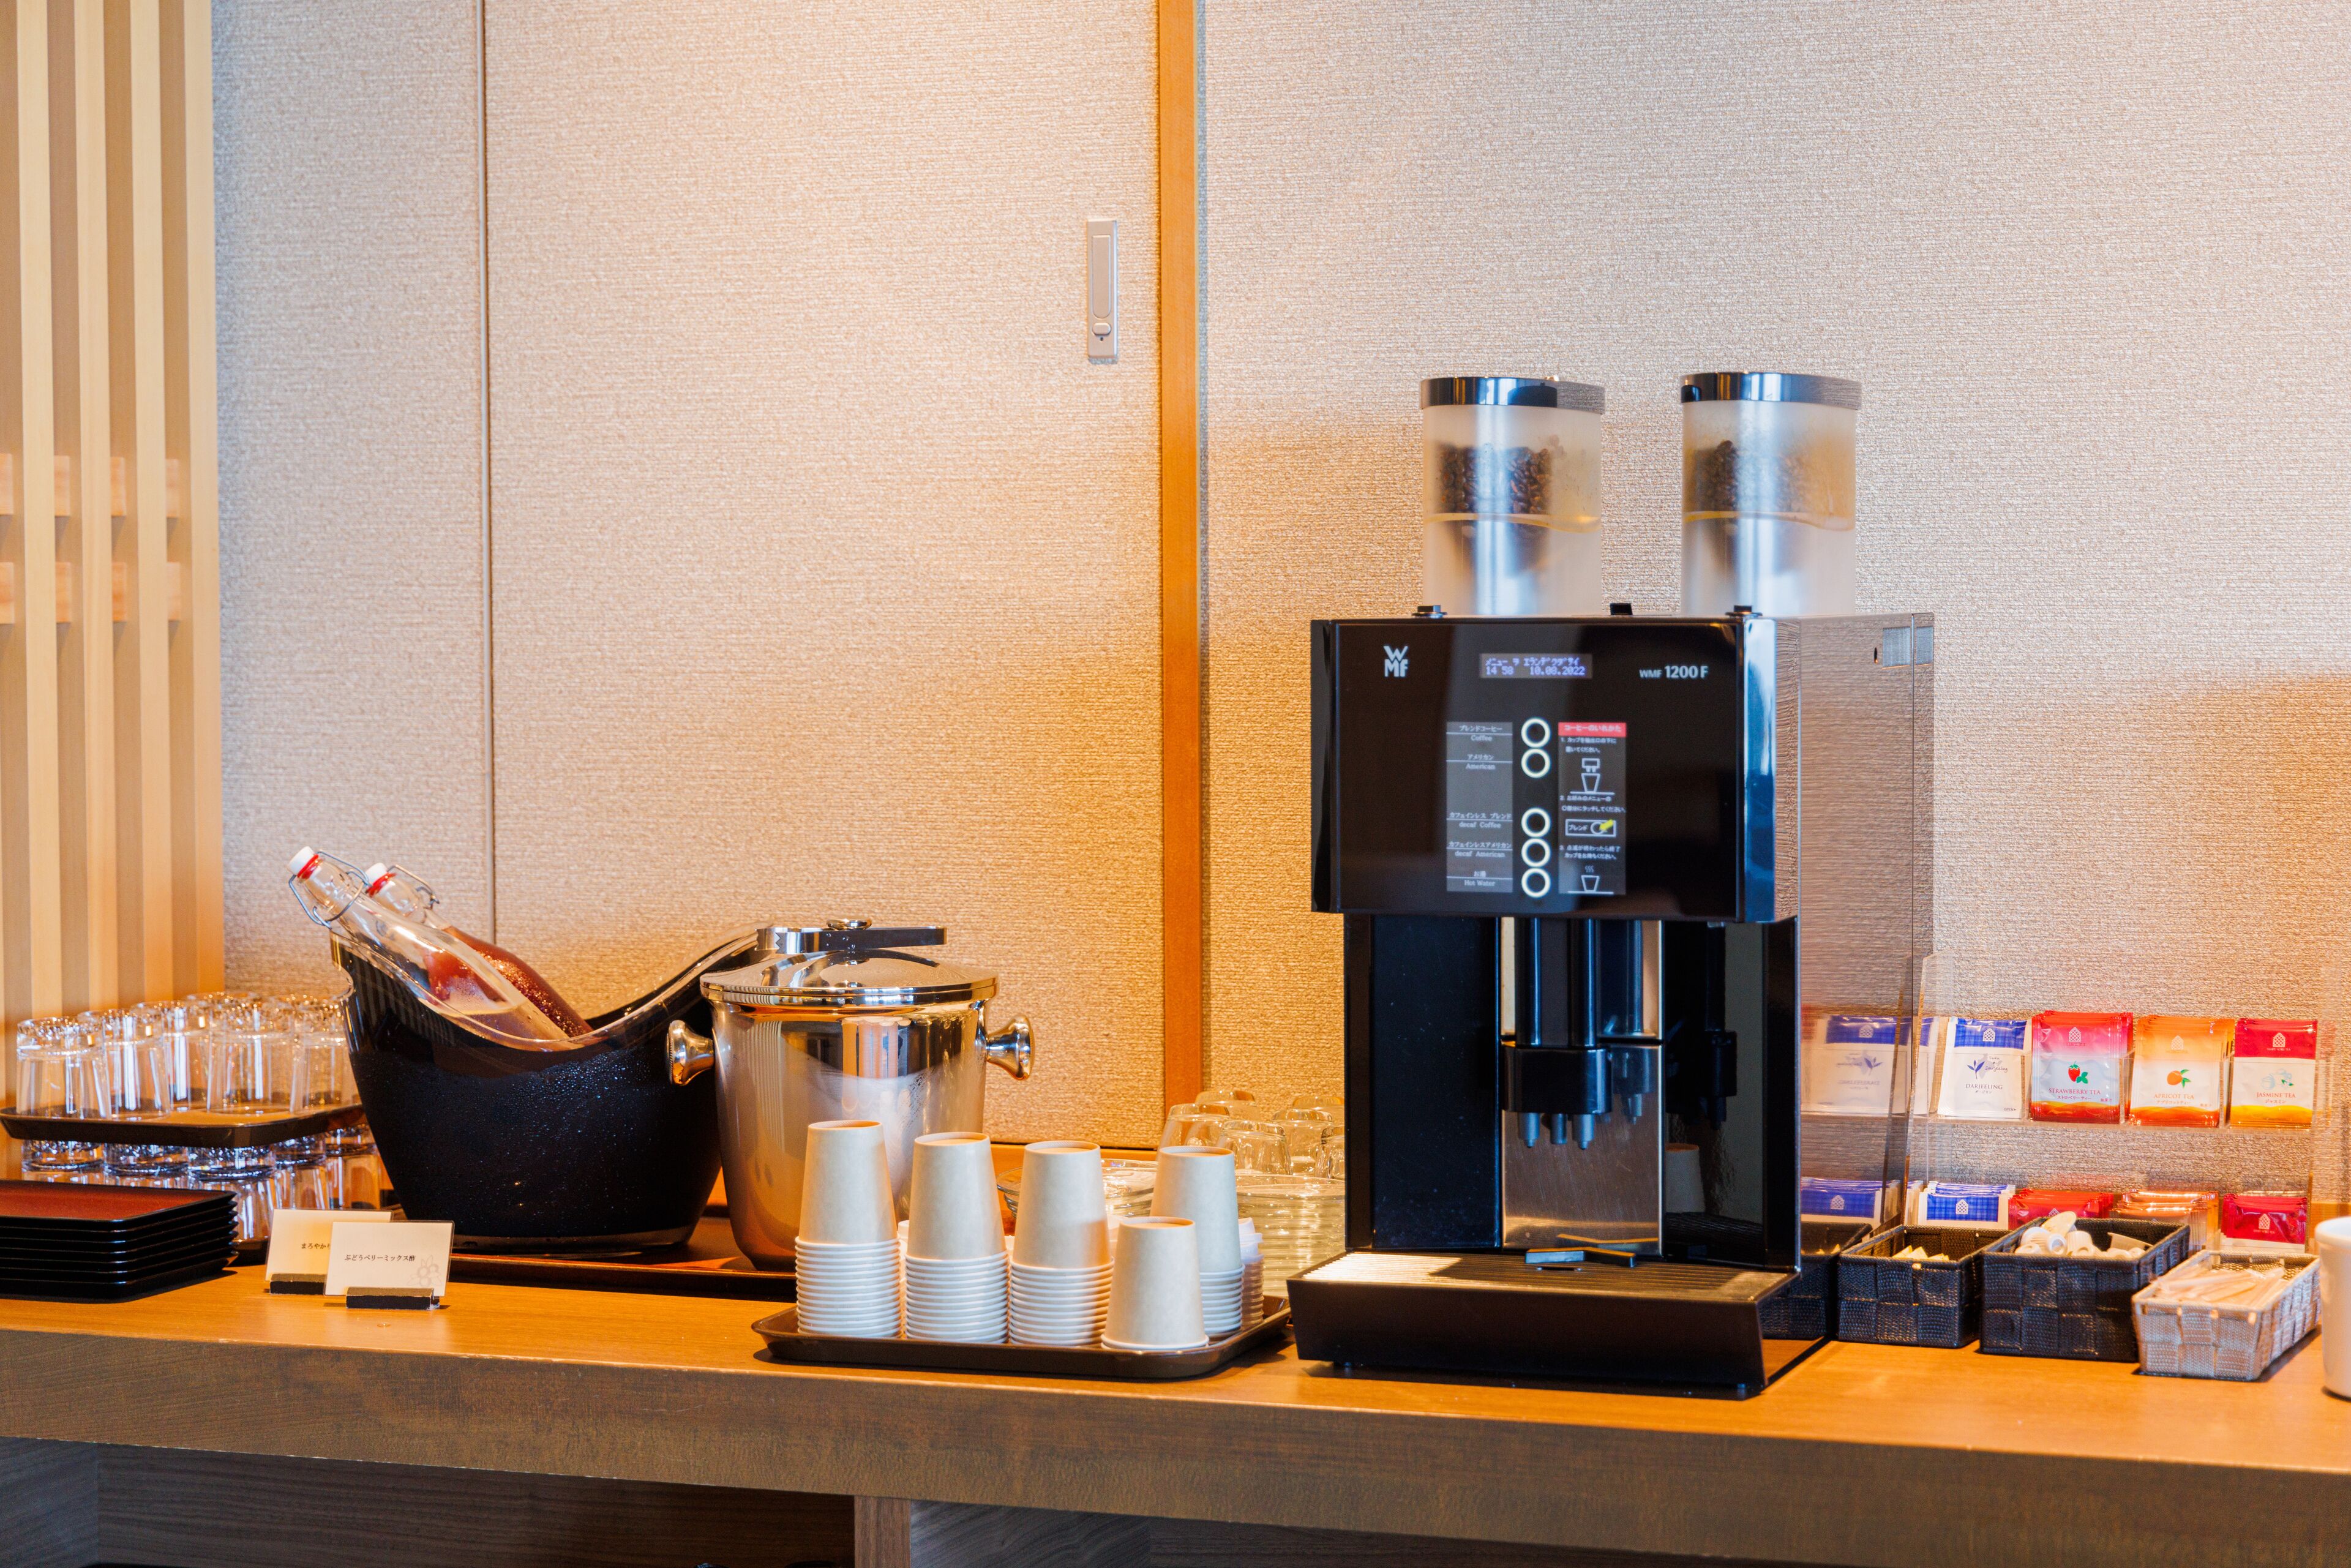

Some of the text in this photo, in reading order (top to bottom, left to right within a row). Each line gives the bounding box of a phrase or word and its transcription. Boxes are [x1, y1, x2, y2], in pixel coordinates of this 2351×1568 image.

[1639, 666, 1709, 678] WMF 1200 F
